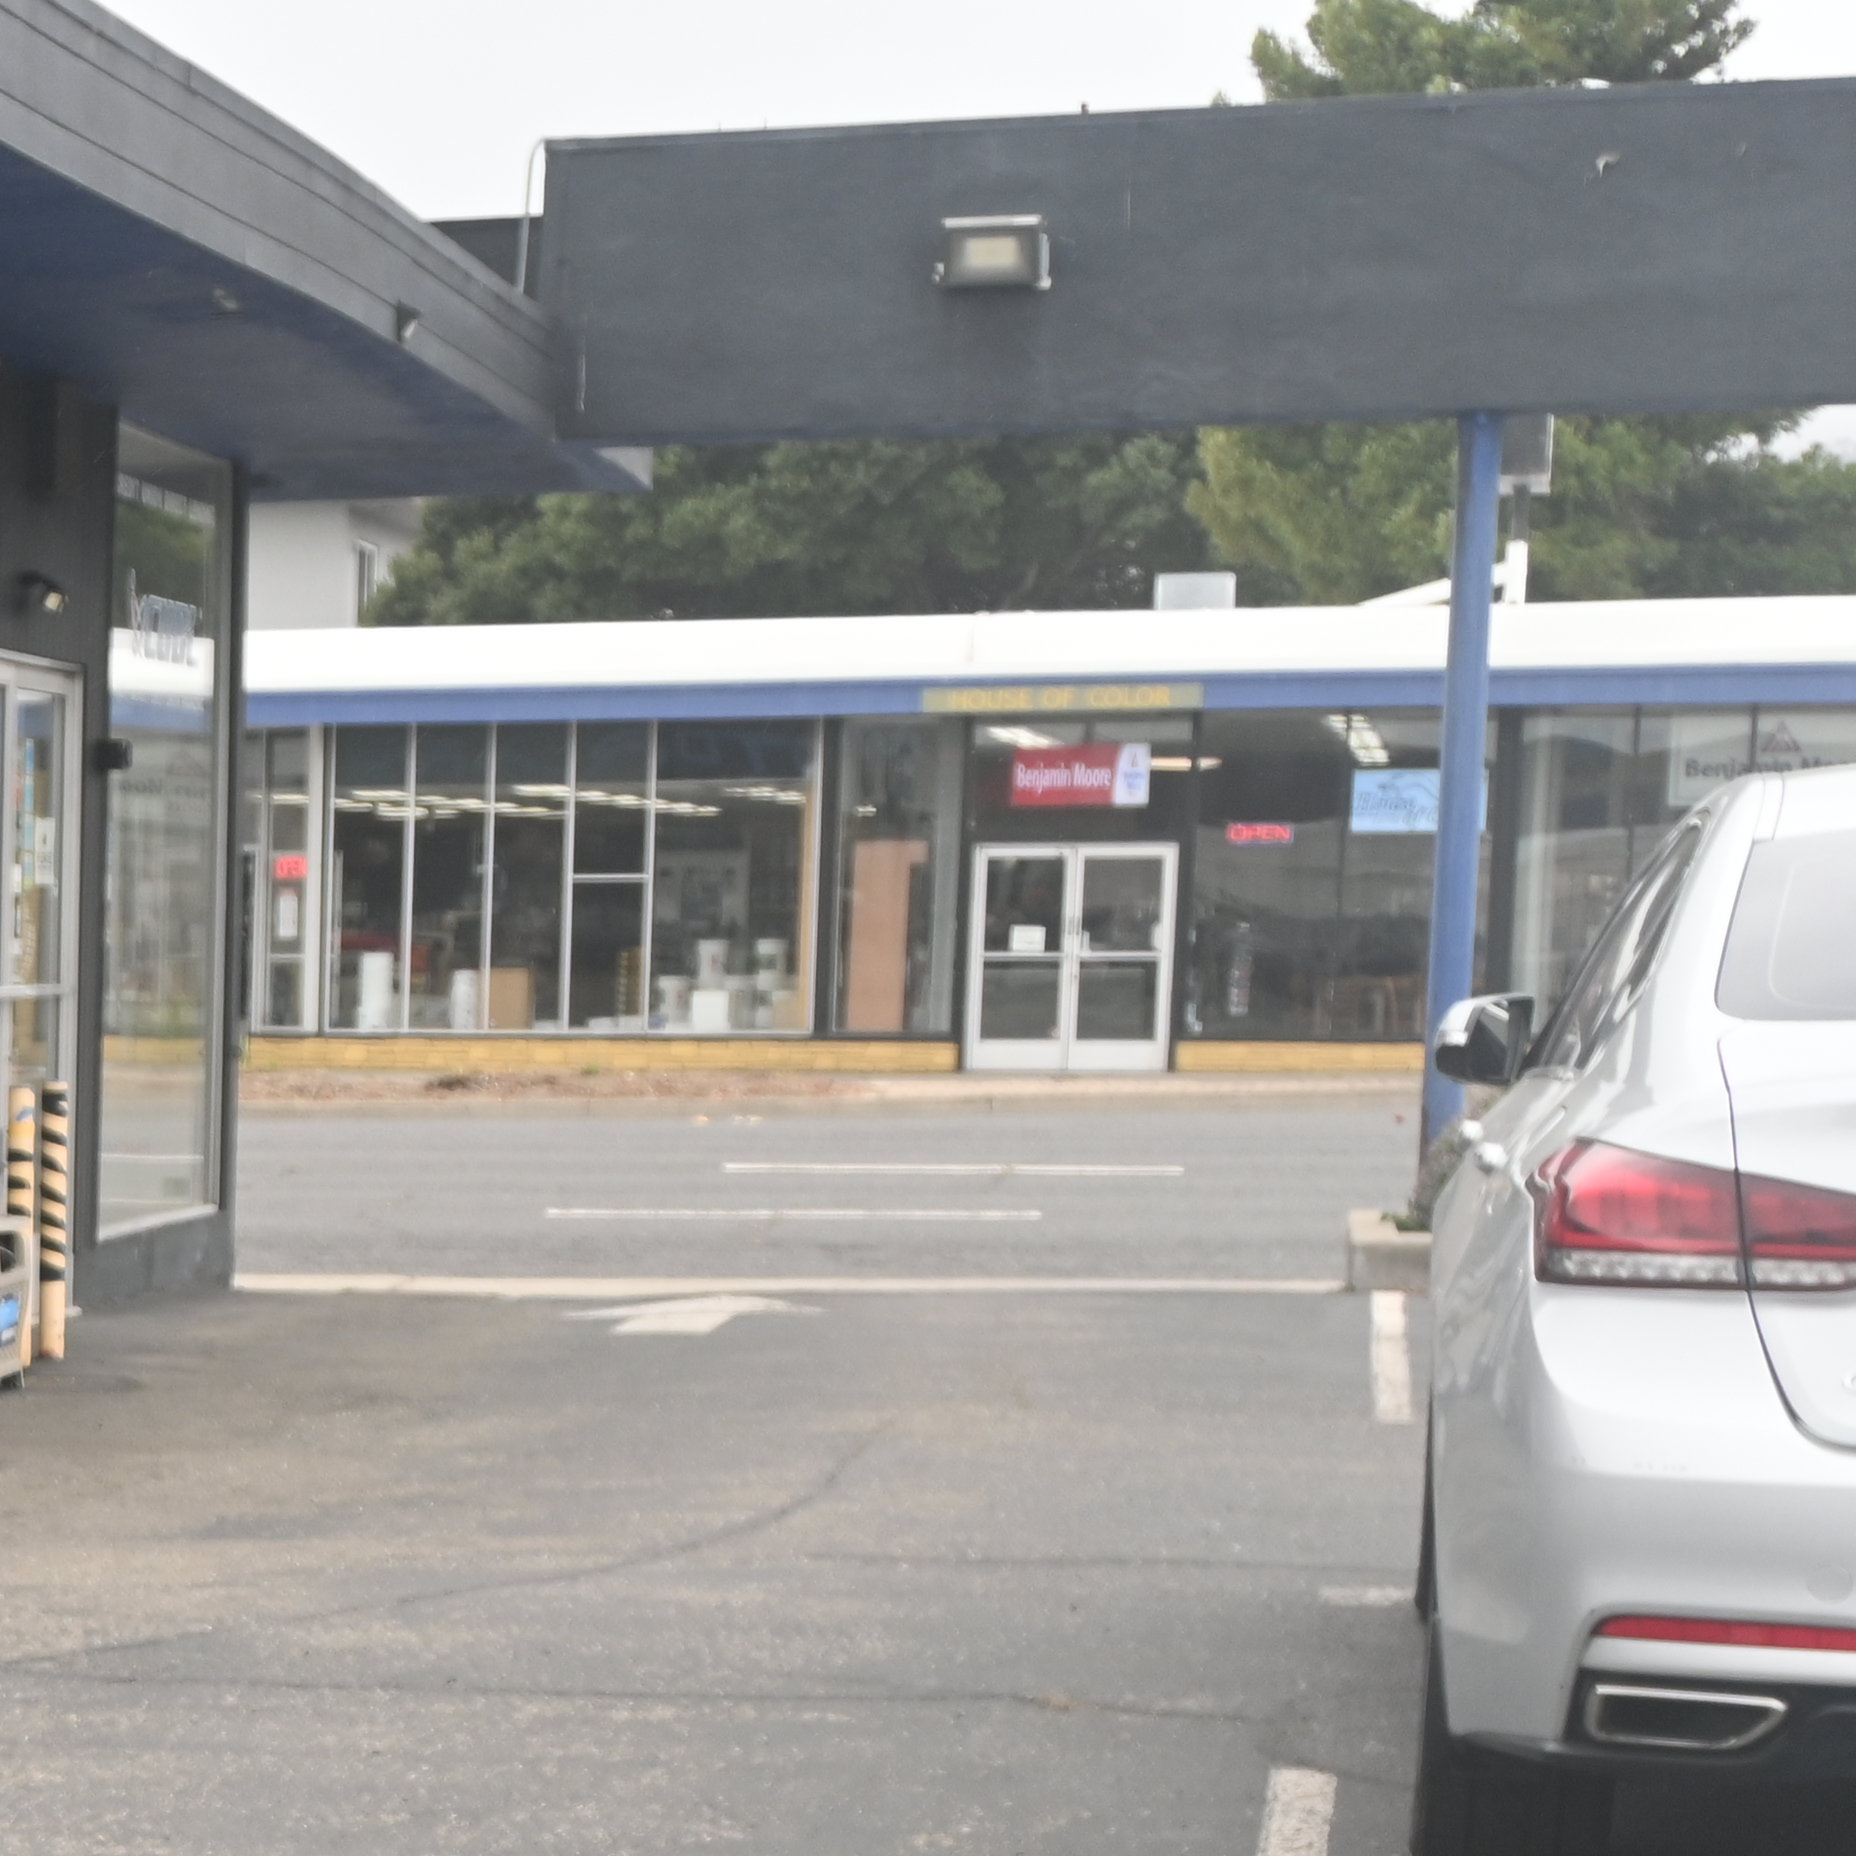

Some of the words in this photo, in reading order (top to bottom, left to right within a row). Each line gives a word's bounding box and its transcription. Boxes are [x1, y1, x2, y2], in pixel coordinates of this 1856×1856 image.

[951, 689, 1031, 709] HOUSE
[1044, 687, 1075, 708] OF
[1089, 685, 1171, 708] COLOR
[1017, 761, 1071, 793] Benjamin
[1073, 762, 1112, 787] Moore
[1229, 824, 1291, 842] OPEN
